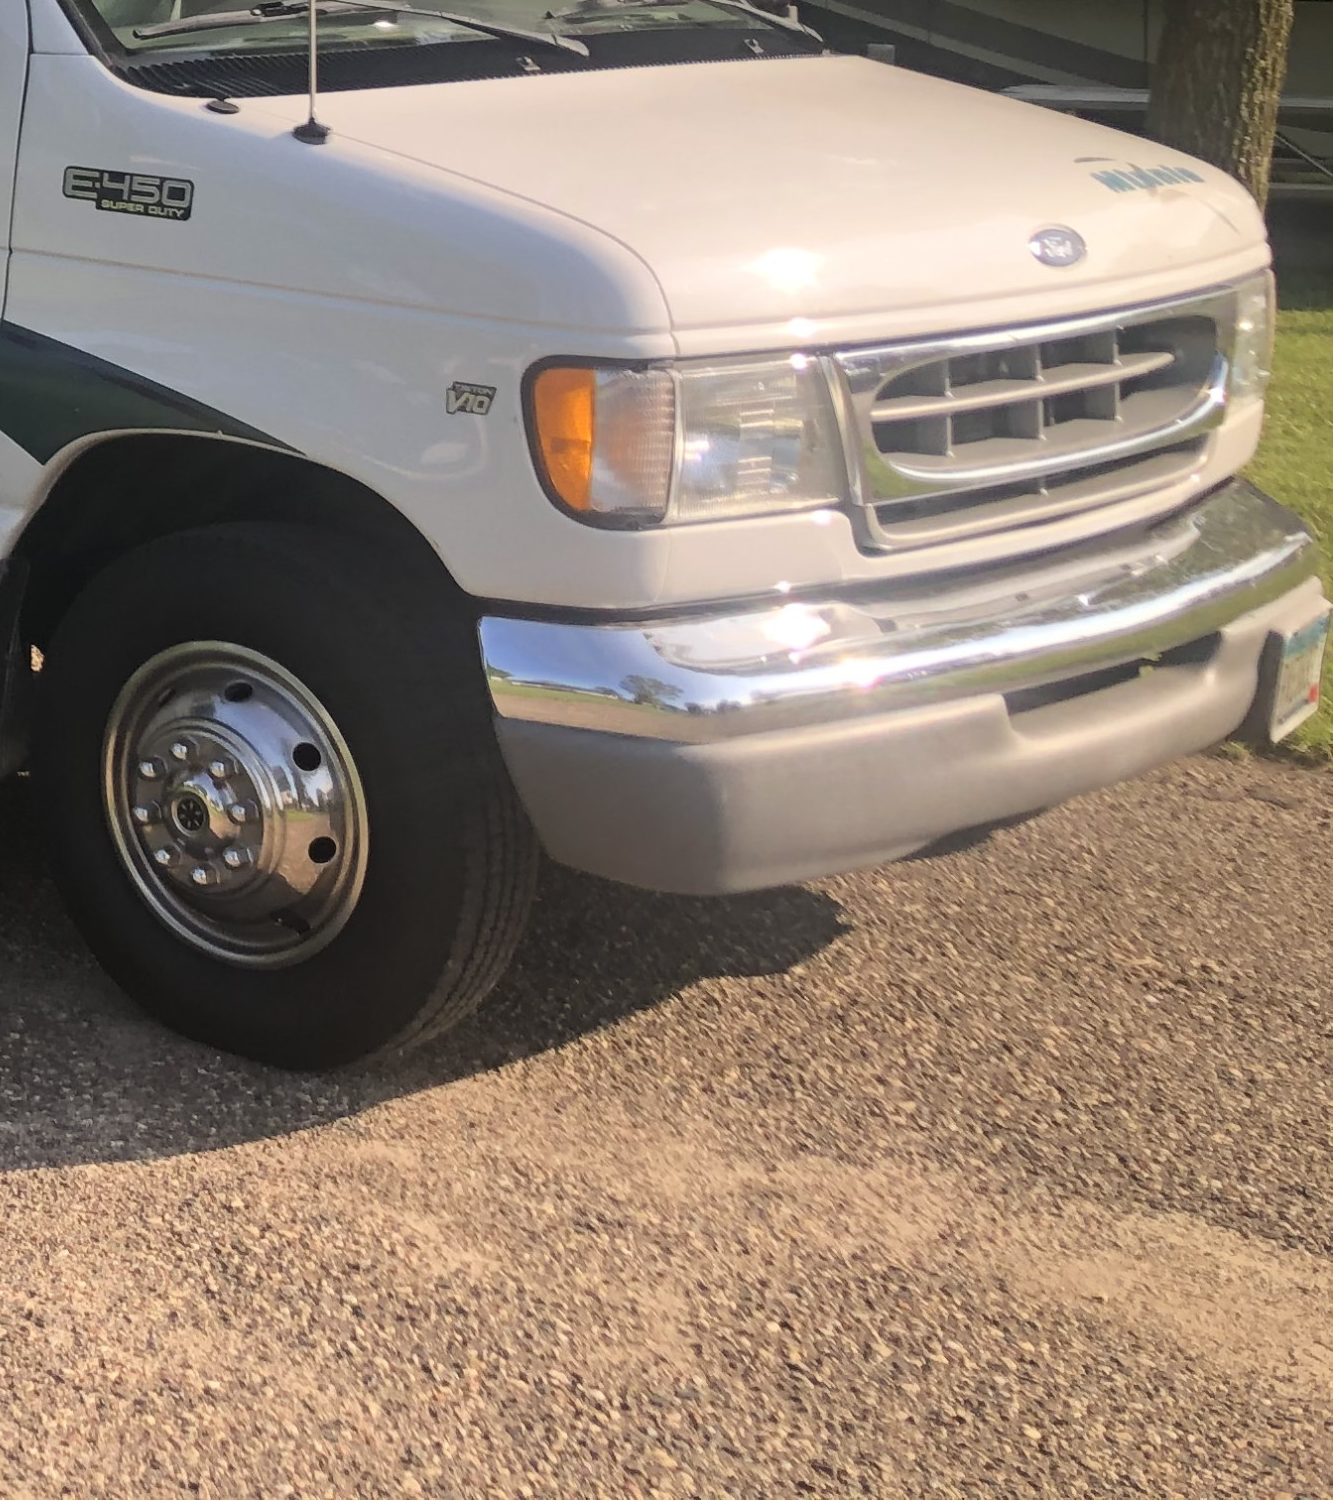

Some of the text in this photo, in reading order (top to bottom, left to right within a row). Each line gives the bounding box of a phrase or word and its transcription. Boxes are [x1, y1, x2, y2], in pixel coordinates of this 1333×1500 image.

[101, 199, 184, 218] SUPER DUTY
[447, 390, 490, 413] V10
